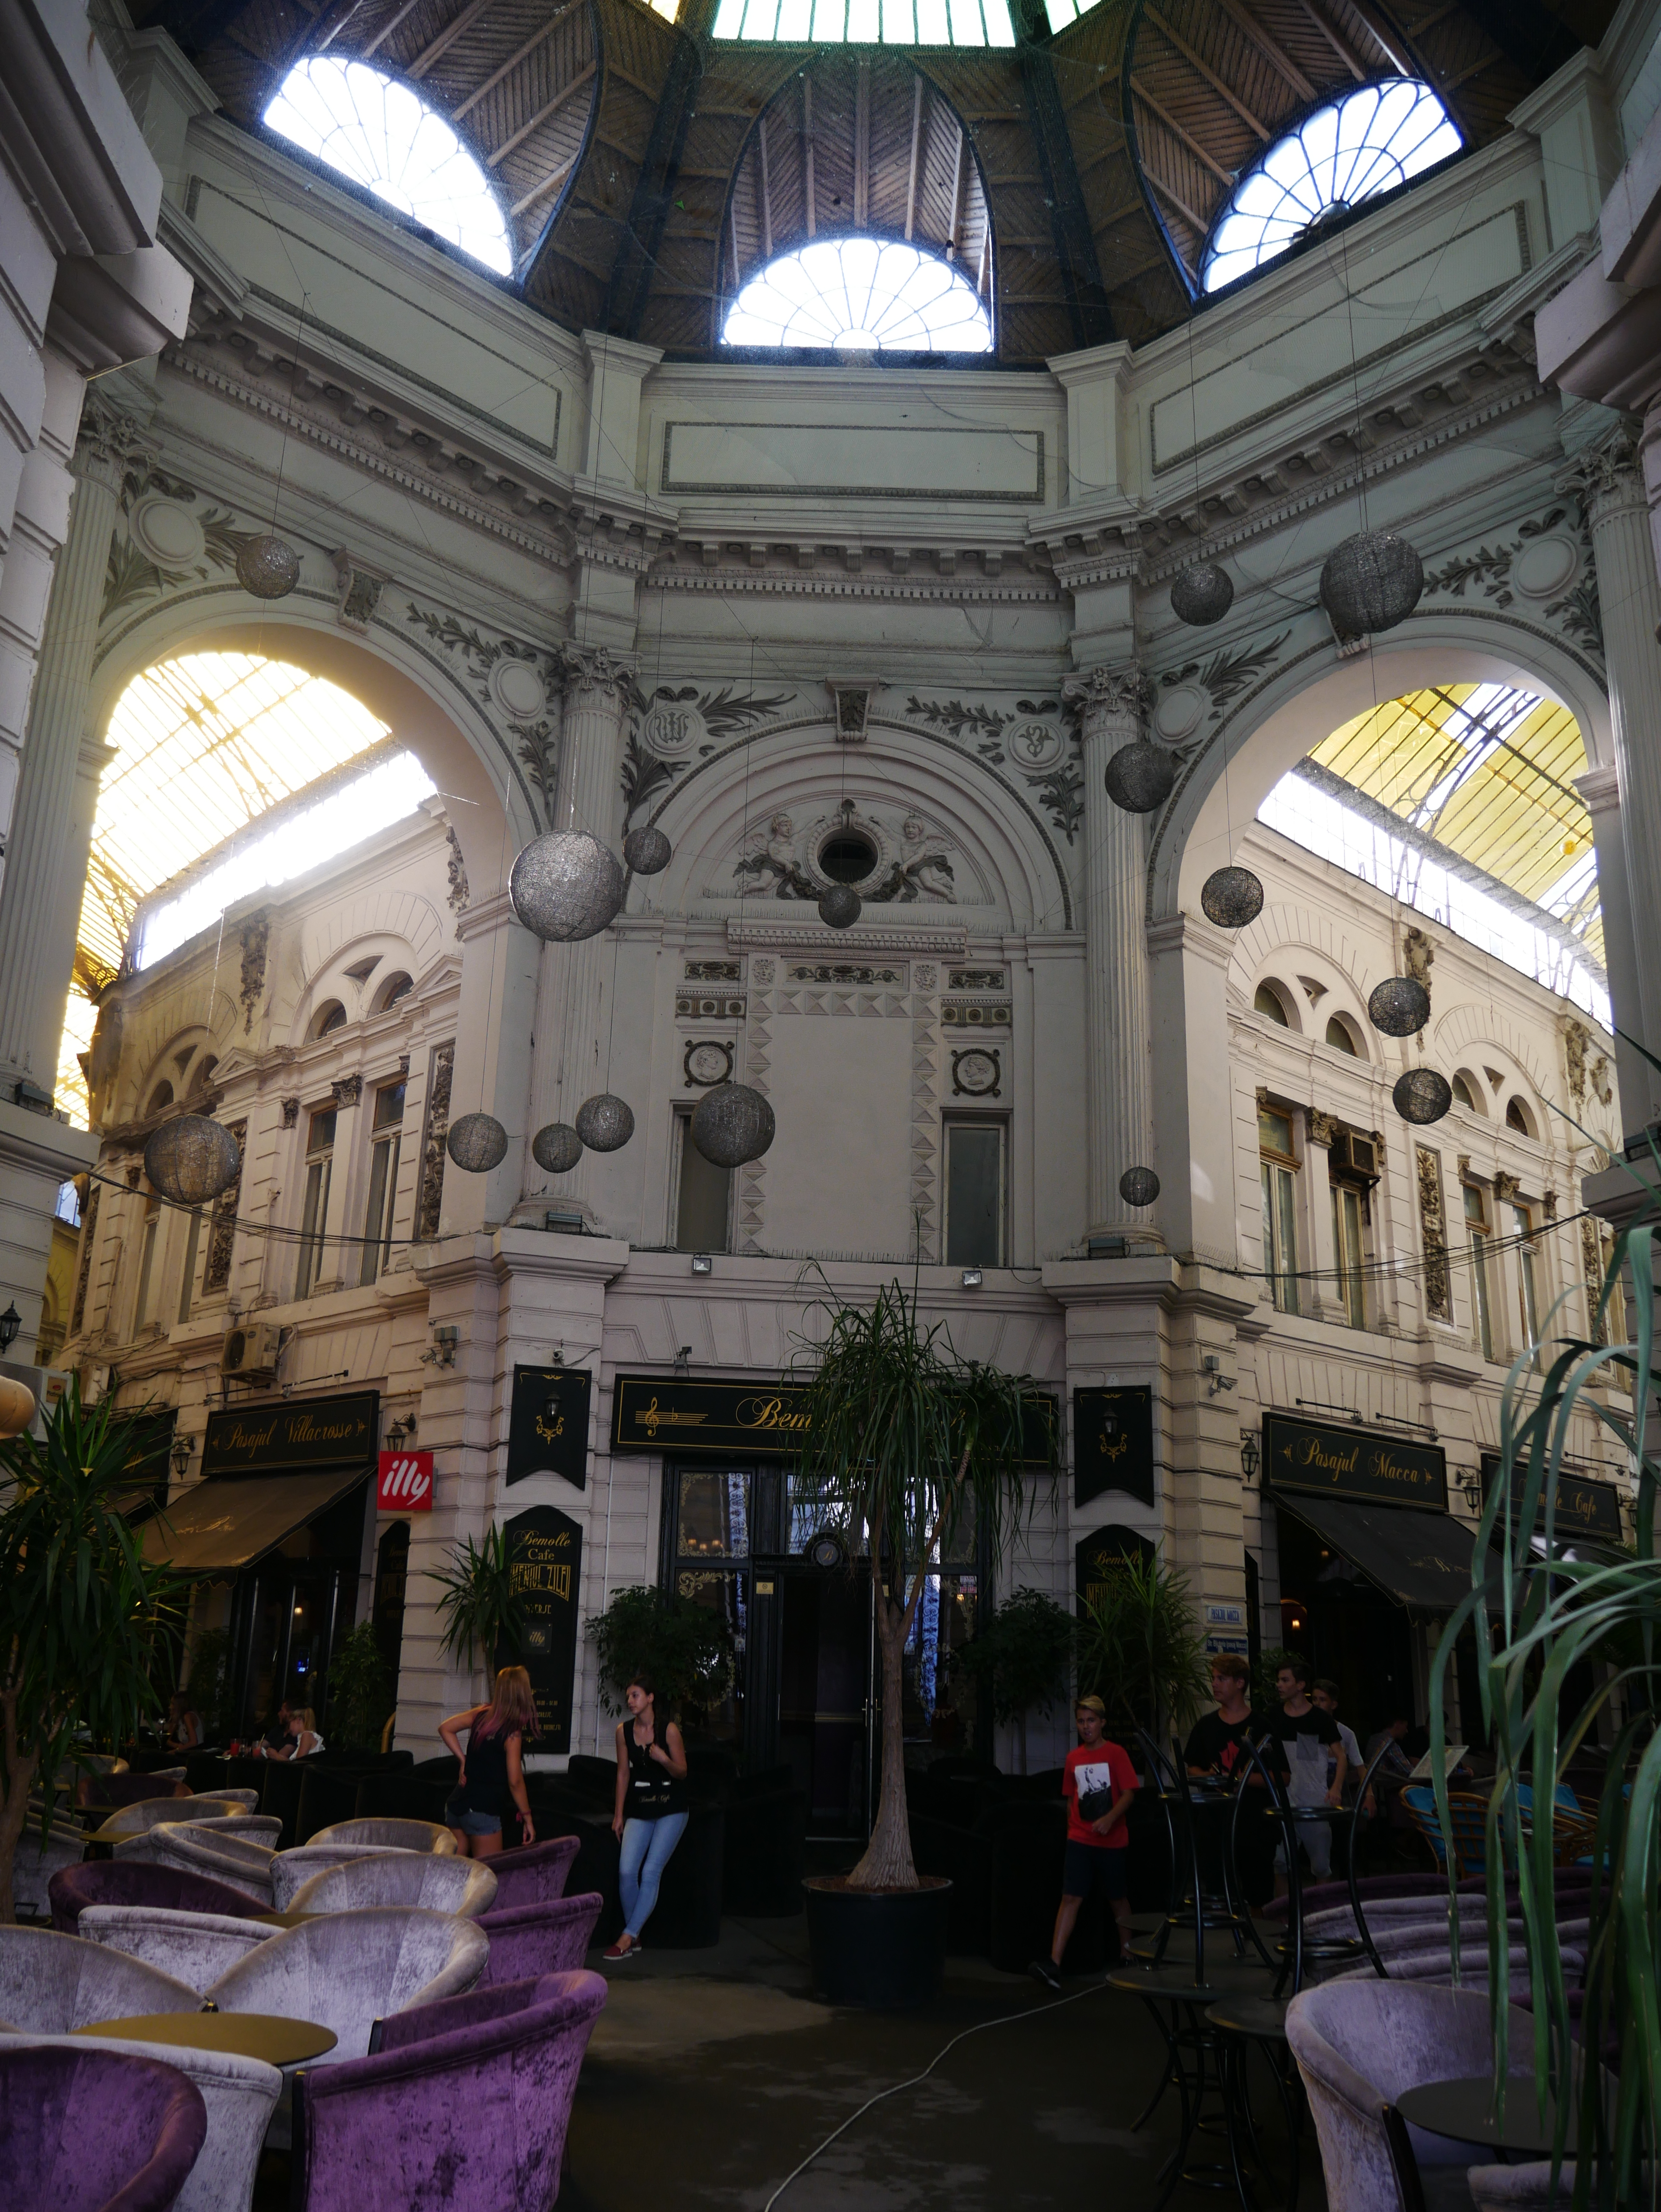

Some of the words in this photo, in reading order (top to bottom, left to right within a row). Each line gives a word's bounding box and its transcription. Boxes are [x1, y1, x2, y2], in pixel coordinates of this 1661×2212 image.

[223, 1419, 277, 1458] Pasajul
[285, 1414, 353, 1443] Villacrosse
[1297, 1436, 1359, 1482] Pasajul
[1368, 1450, 1420, 1483] Macca
[382, 1459, 430, 1506] illy
[1569, 1491, 1597, 1524] Cafe
[513, 1529, 572, 1547] Bemolle
[527, 1548, 555, 1561] Cafe
[547, 1566, 569, 1599] ZILEI
[529, 1631, 545, 1646] illy
